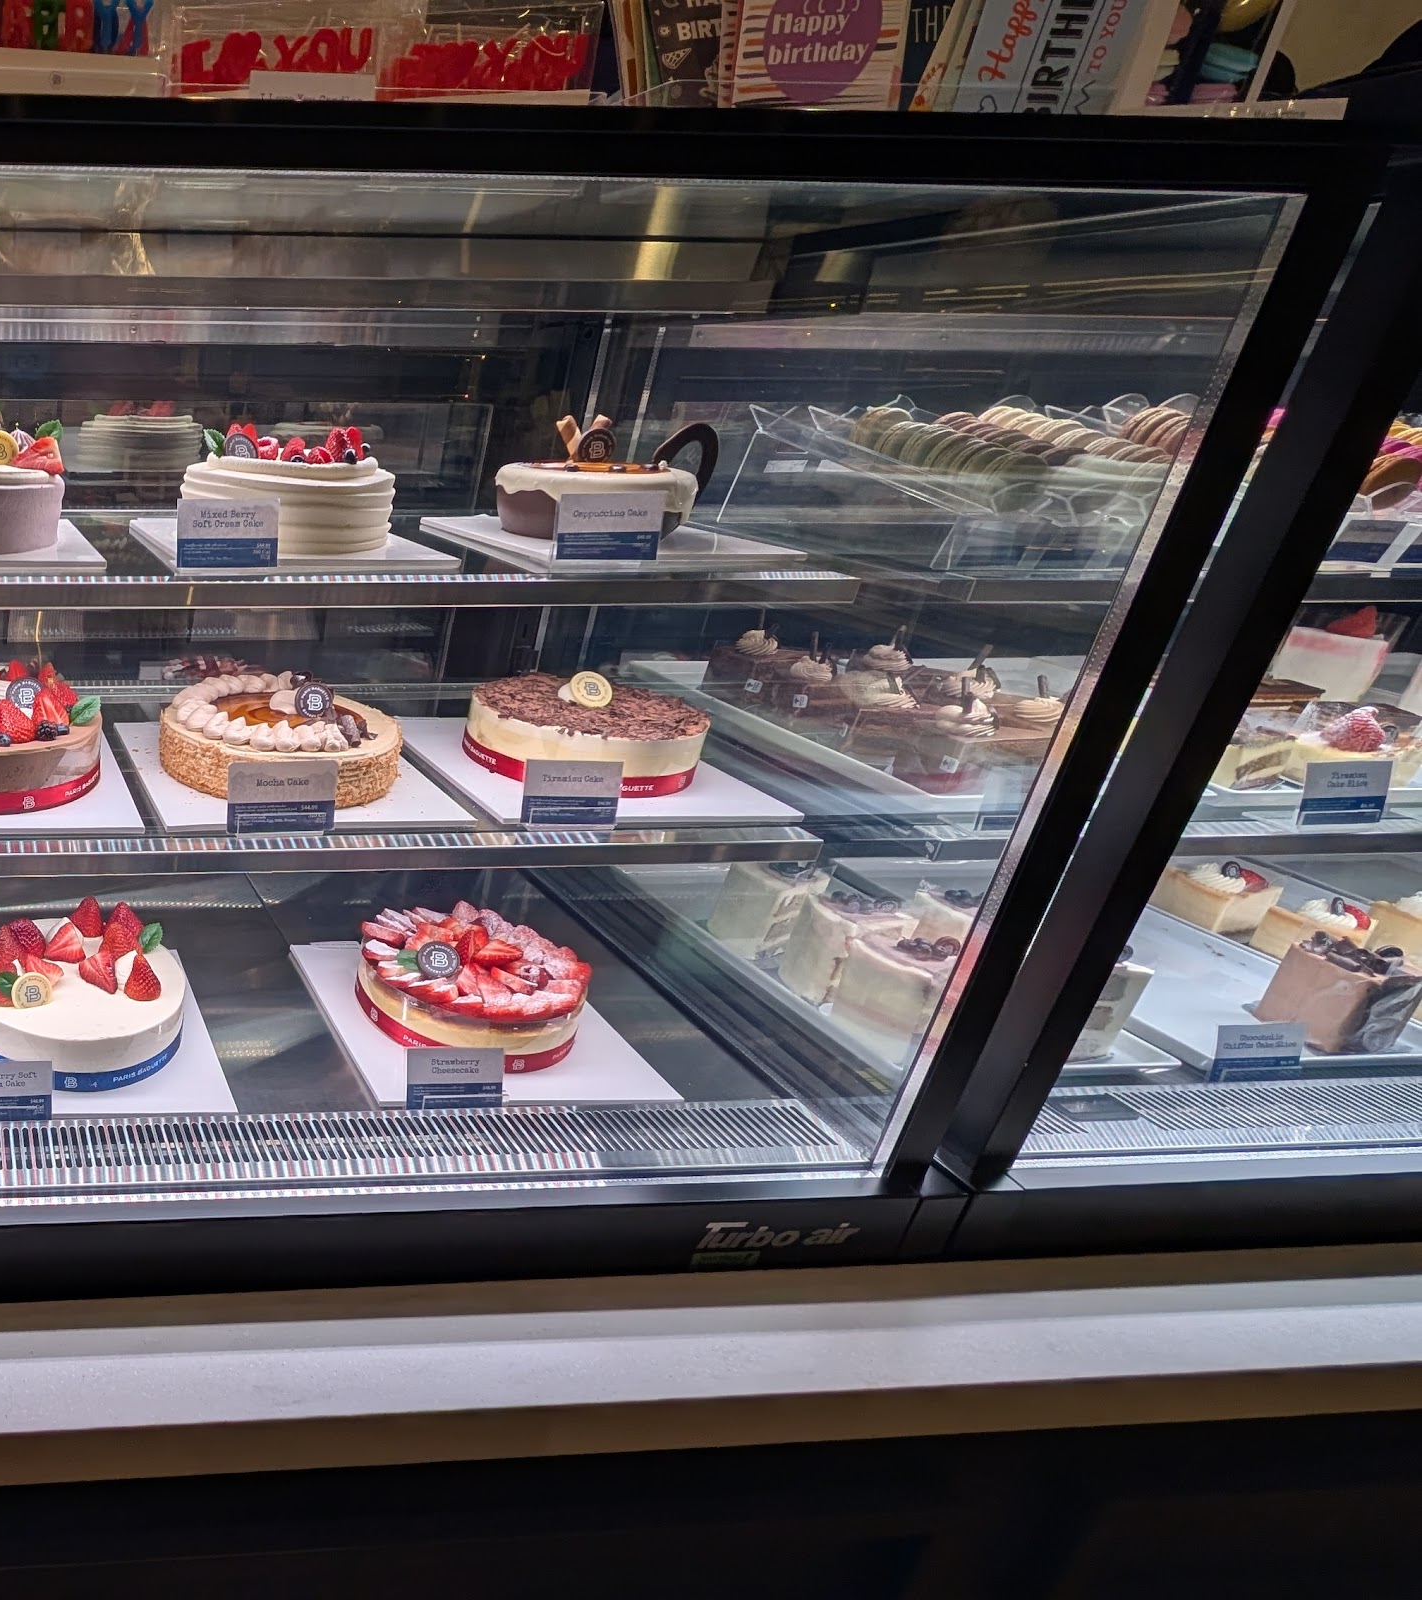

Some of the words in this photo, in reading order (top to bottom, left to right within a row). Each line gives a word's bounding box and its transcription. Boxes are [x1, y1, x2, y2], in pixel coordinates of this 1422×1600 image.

[772, 12, 850, 36] Happy
[766, 41, 870, 66] birthday
[1086, 45, 1108, 74] TO
[200, 510, 228, 518] Mixed
[230, 510, 256, 520] Berry
[573, 509, 625, 520] Cappuccino
[627, 508, 648, 517] Cake
[192, 519, 212, 528] Soft
[214, 520, 240, 528] Cream
[243, 520, 264, 528] Cake
[542, 774, 582, 783] Tiramisu
[584, 775, 604, 783] Cake
[1331, 771, 1368, 780] Tiramisu
[256, 778, 285, 787] Mocha
[287, 777, 310, 786] Cake
[1327, 780, 1346, 789] Cake
[1347, 780, 1368, 788] Slice
[64, 785, 82, 797] PARIS
[620, 783, 654, 792] GUETTE
[1240, 1033, 1284, 1041] Chocoholic
[1223, 1042, 1253, 1050] Chiffon
[1256, 1041, 1274, 1049] Cake
[431, 1058, 480, 1067] Strawberry
[112, 1071, 136, 1083] PARIS
[137, 1053, 169, 1076] BAGUETTE
[431, 1066, 480, 1074] Cheesecake
[18, 1071, 37, 1079] Soft
[696, 1221, 800, 1249] Turbo
[803, 1222, 861, 1245] air
